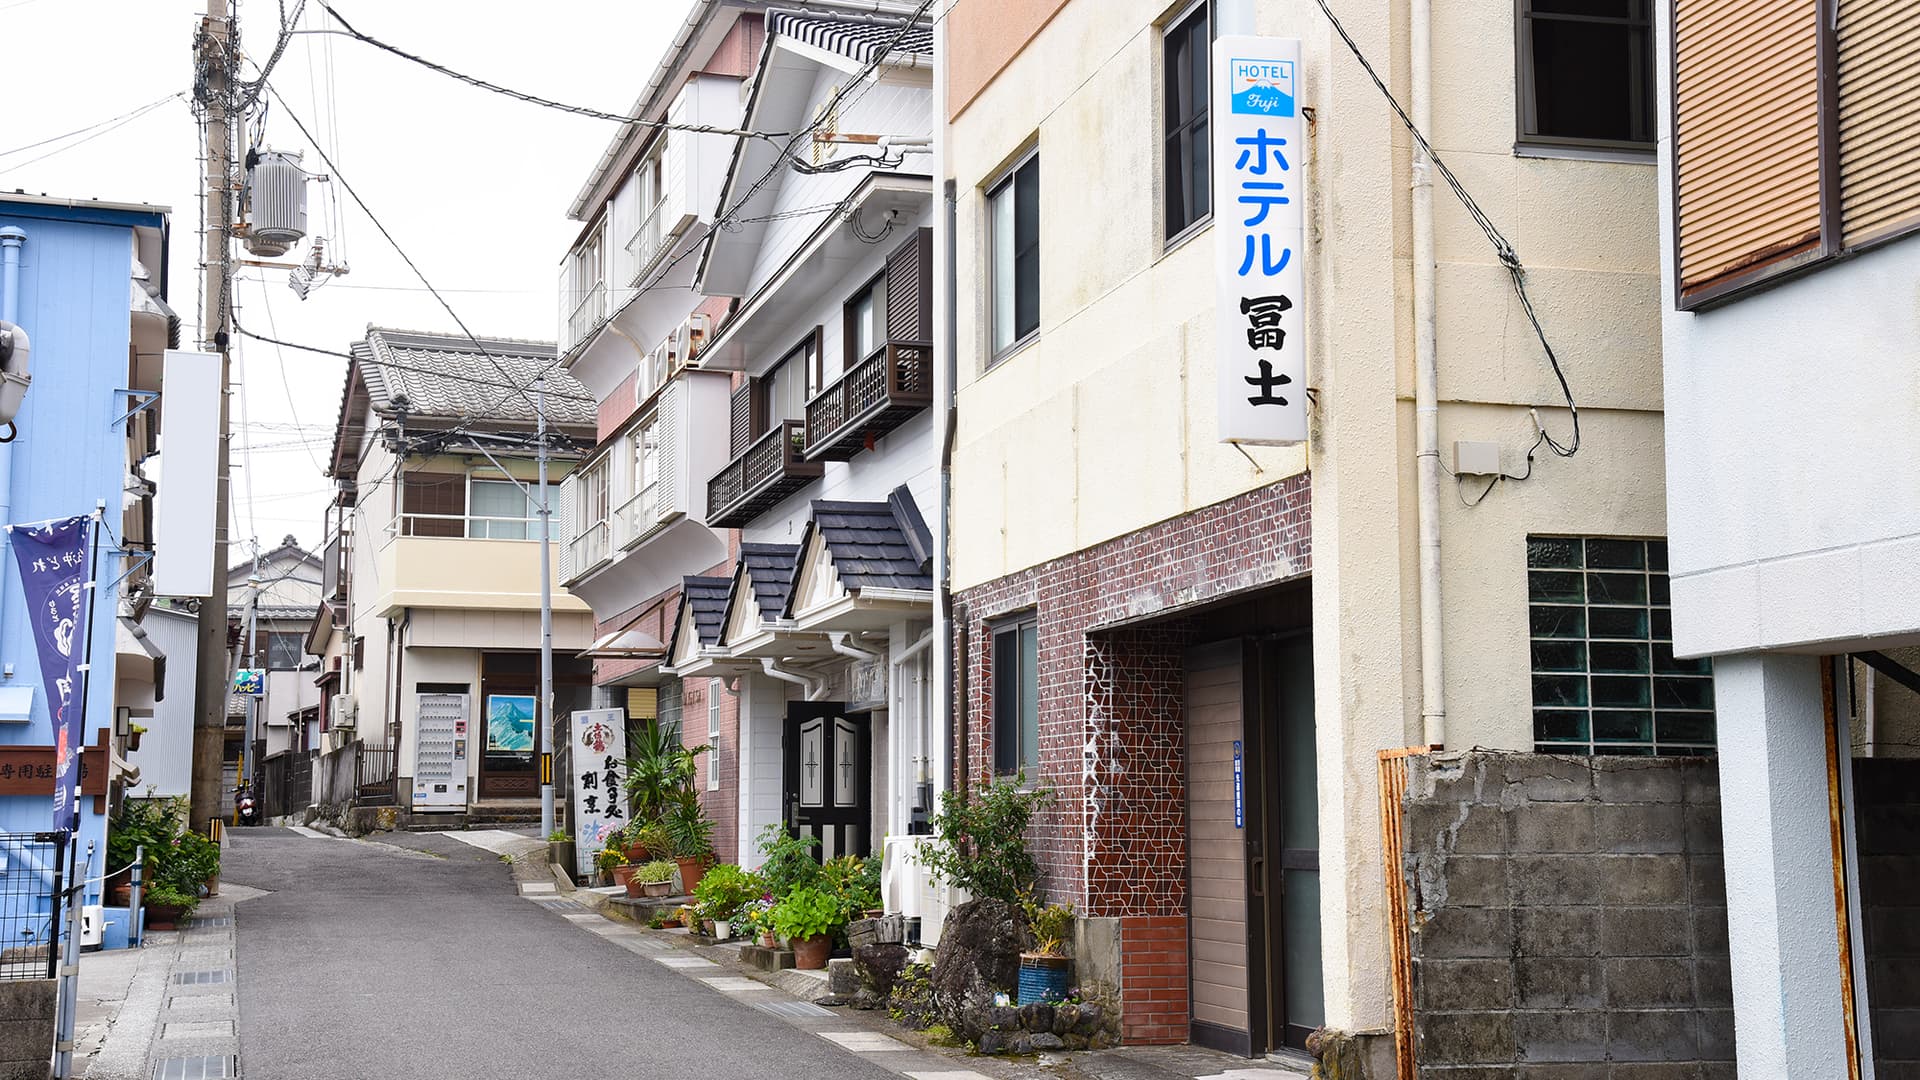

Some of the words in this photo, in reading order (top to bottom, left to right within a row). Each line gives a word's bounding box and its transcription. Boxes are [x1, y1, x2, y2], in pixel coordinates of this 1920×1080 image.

[1239, 65, 1289, 79] HOTEL
[1246, 93, 1279, 113] Fuji
[1235, 128, 1291, 277] ホテル
